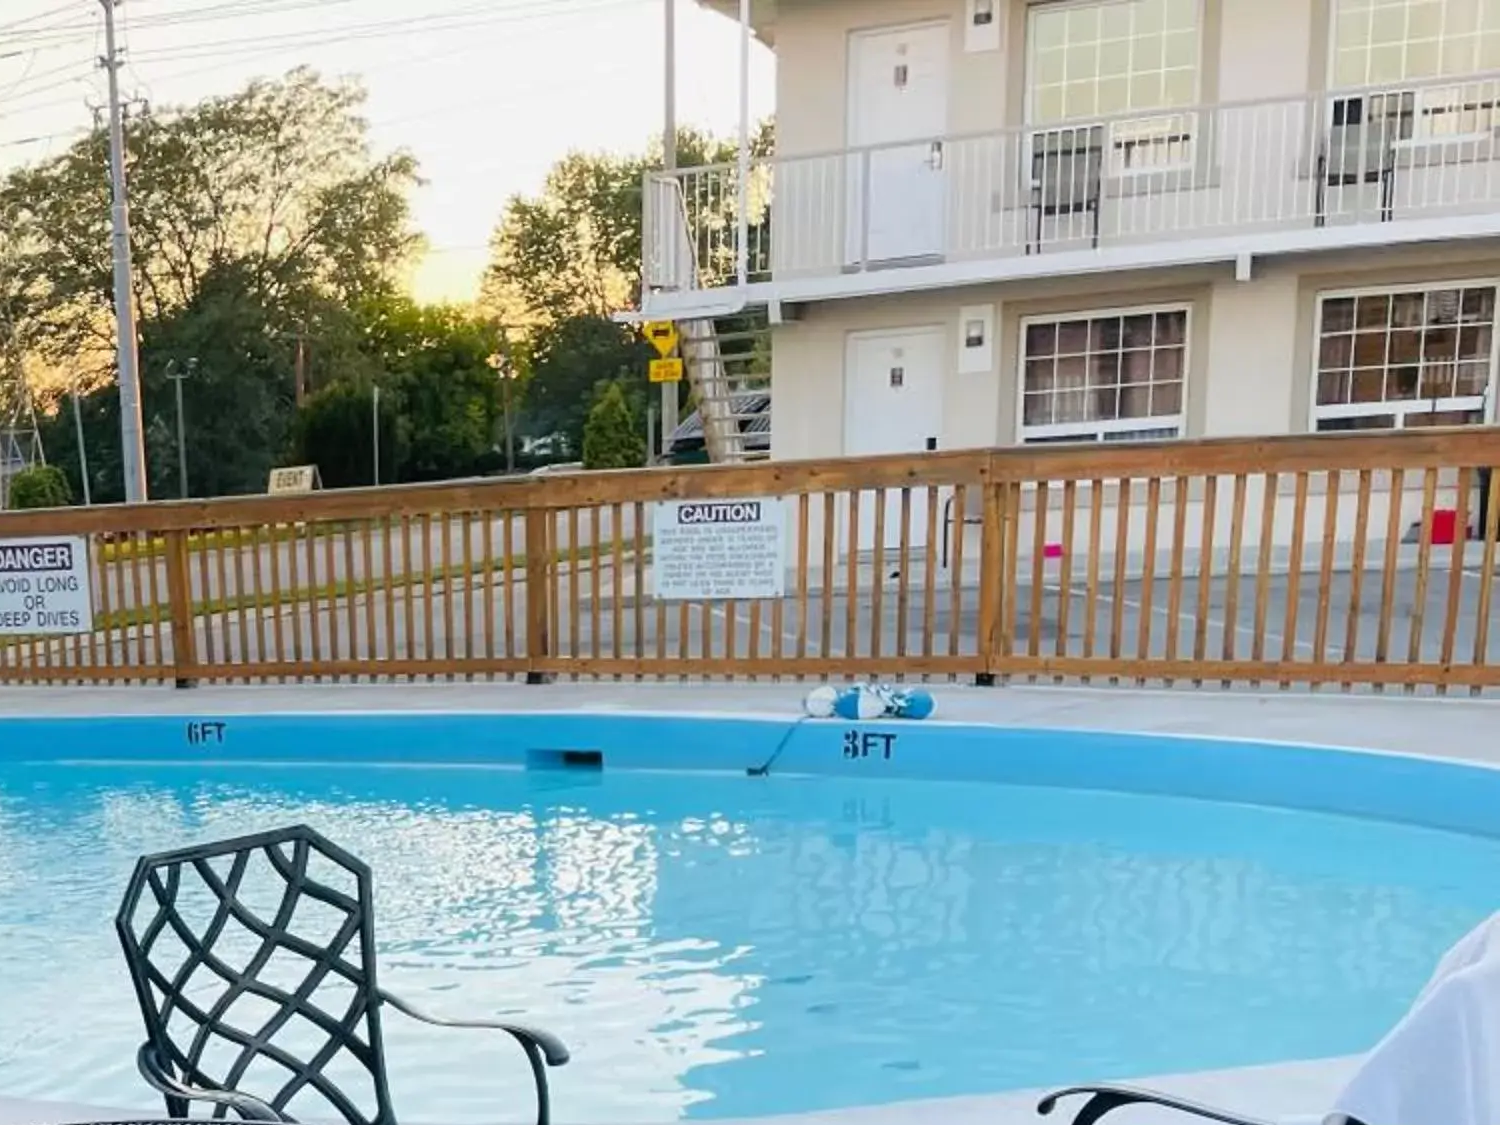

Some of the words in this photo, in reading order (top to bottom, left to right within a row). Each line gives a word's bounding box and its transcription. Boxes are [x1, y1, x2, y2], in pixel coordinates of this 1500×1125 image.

[680, 503, 758, 523] CAUTION
[37, 575, 79, 593] LONG
[23, 595, 45, 610] OR
[37, 610, 79, 626] DIVES
